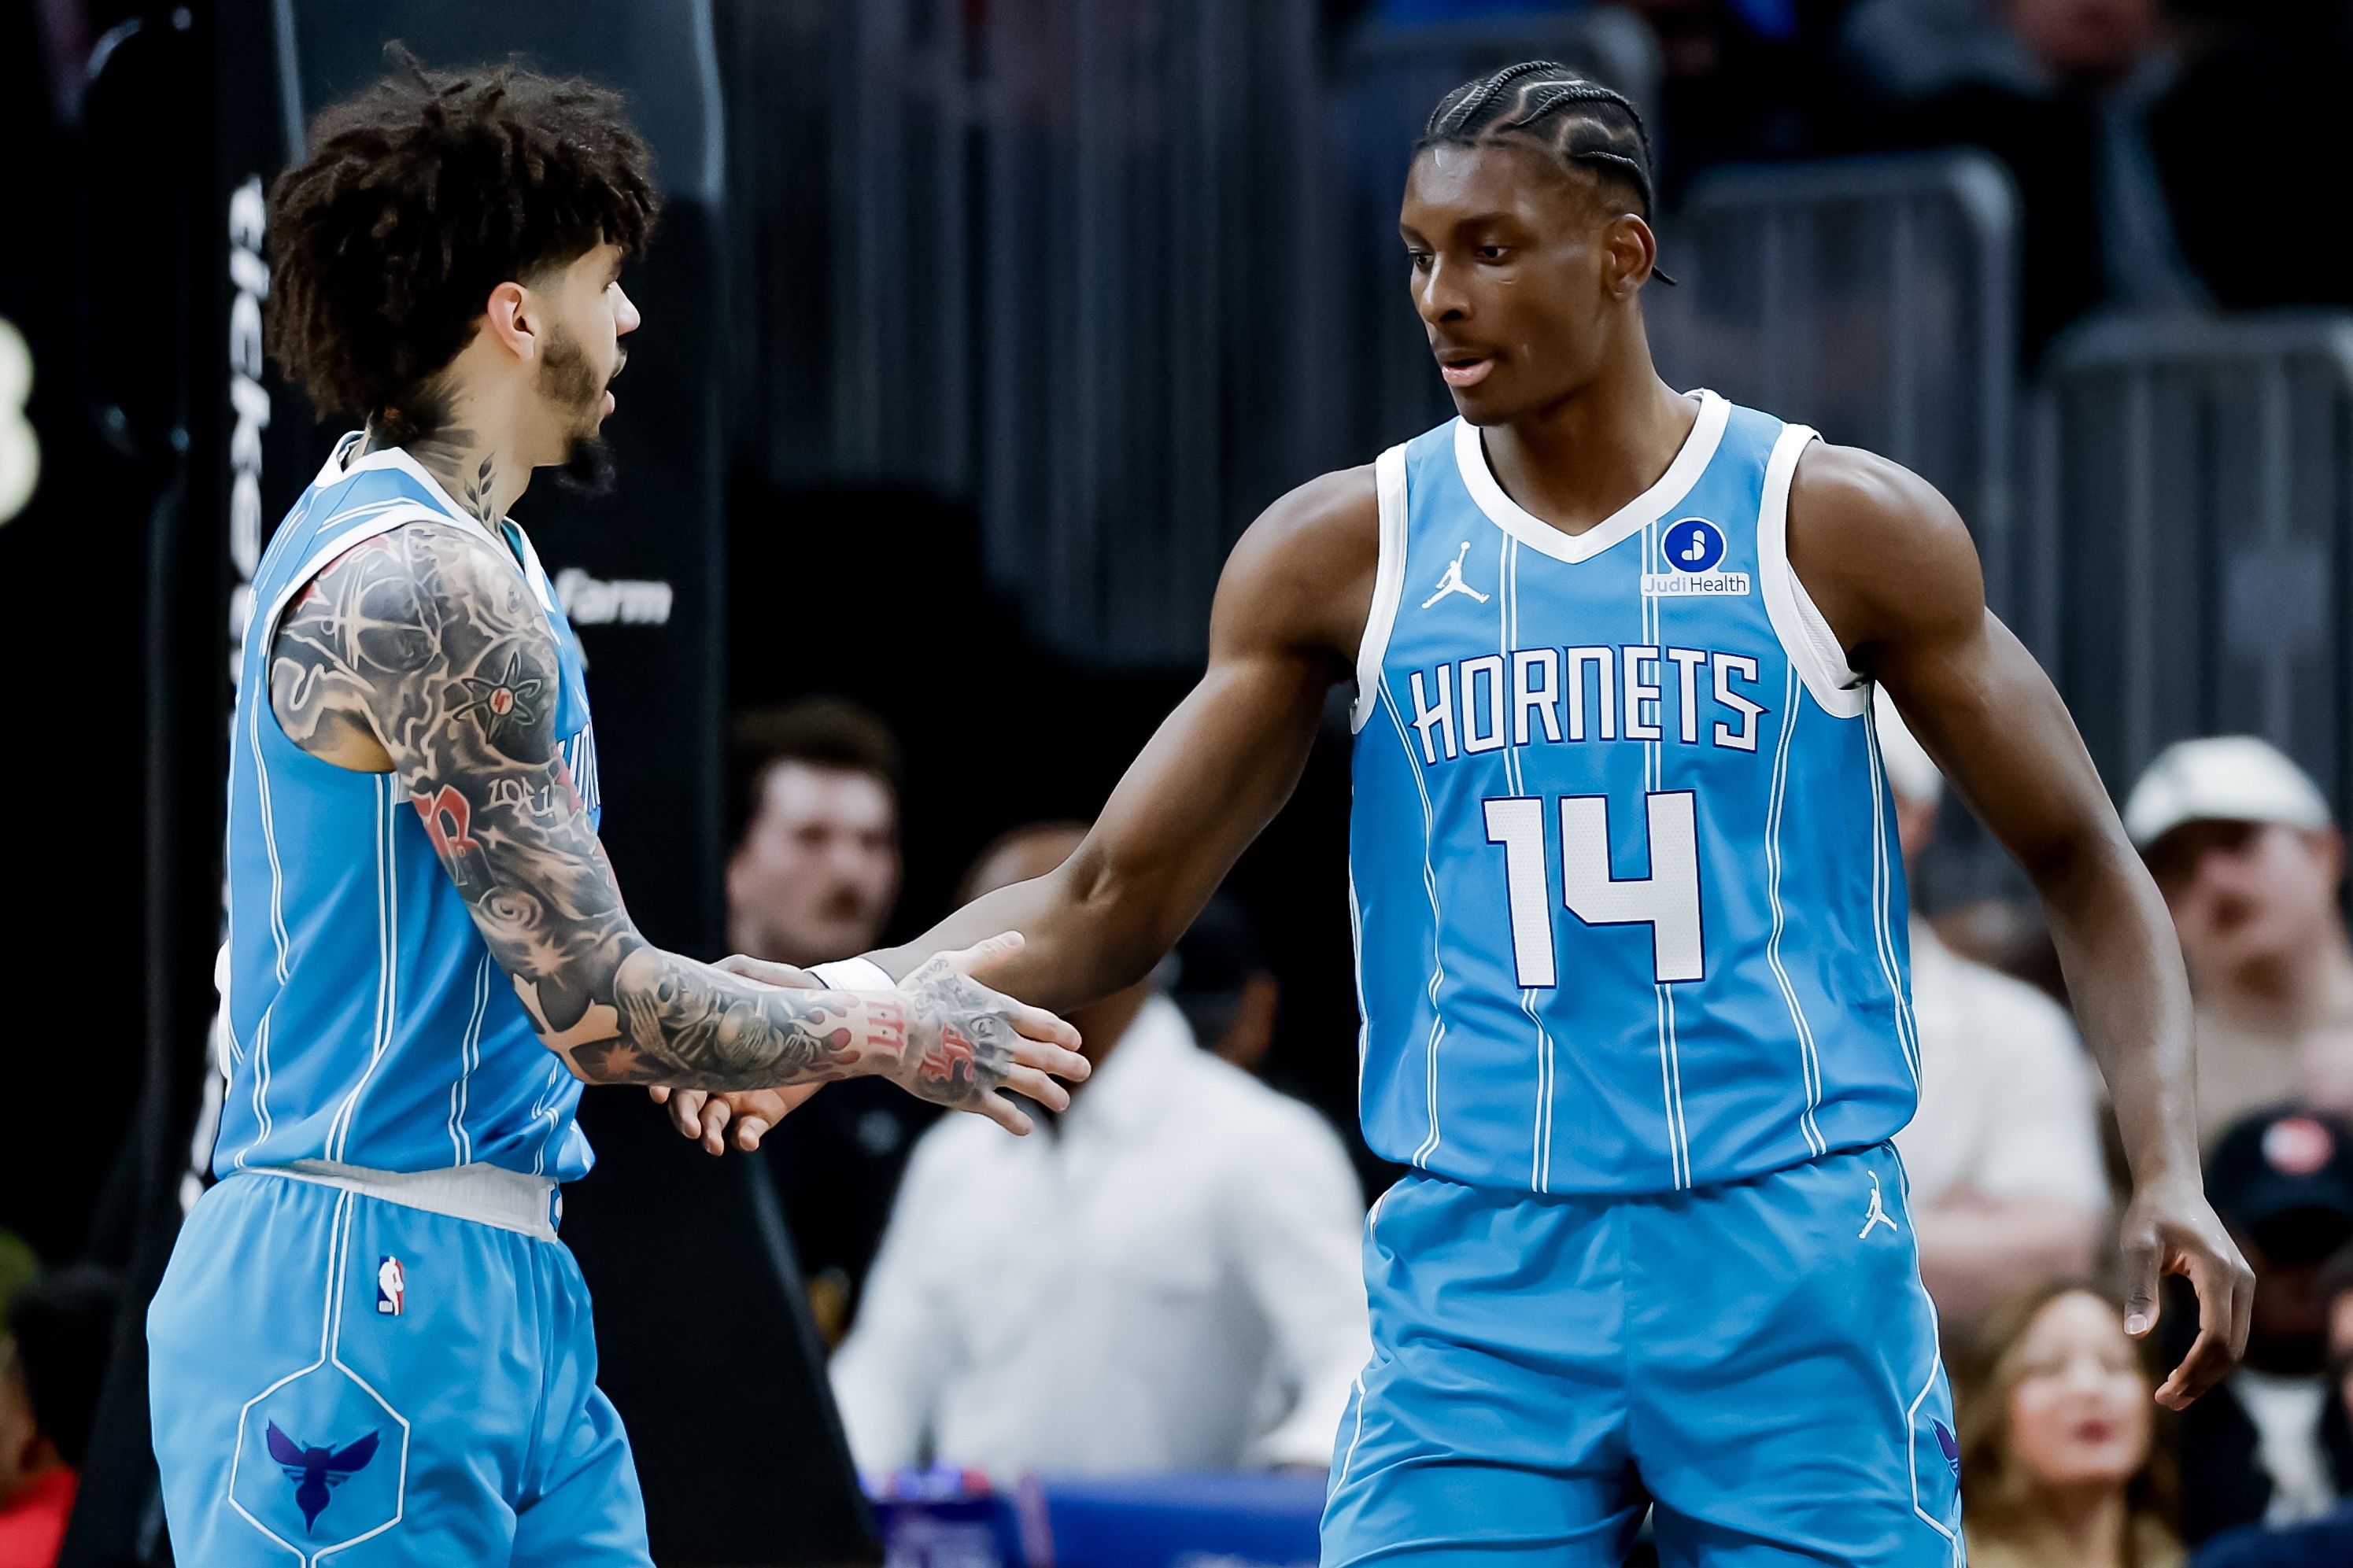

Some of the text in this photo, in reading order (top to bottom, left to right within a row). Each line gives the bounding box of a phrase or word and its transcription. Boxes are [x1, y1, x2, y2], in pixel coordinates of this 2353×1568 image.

[1644, 574, 1746, 593] Judi Health
[1408, 644, 1771, 766] HORNETS
[1481, 789, 1706, 989] 14
